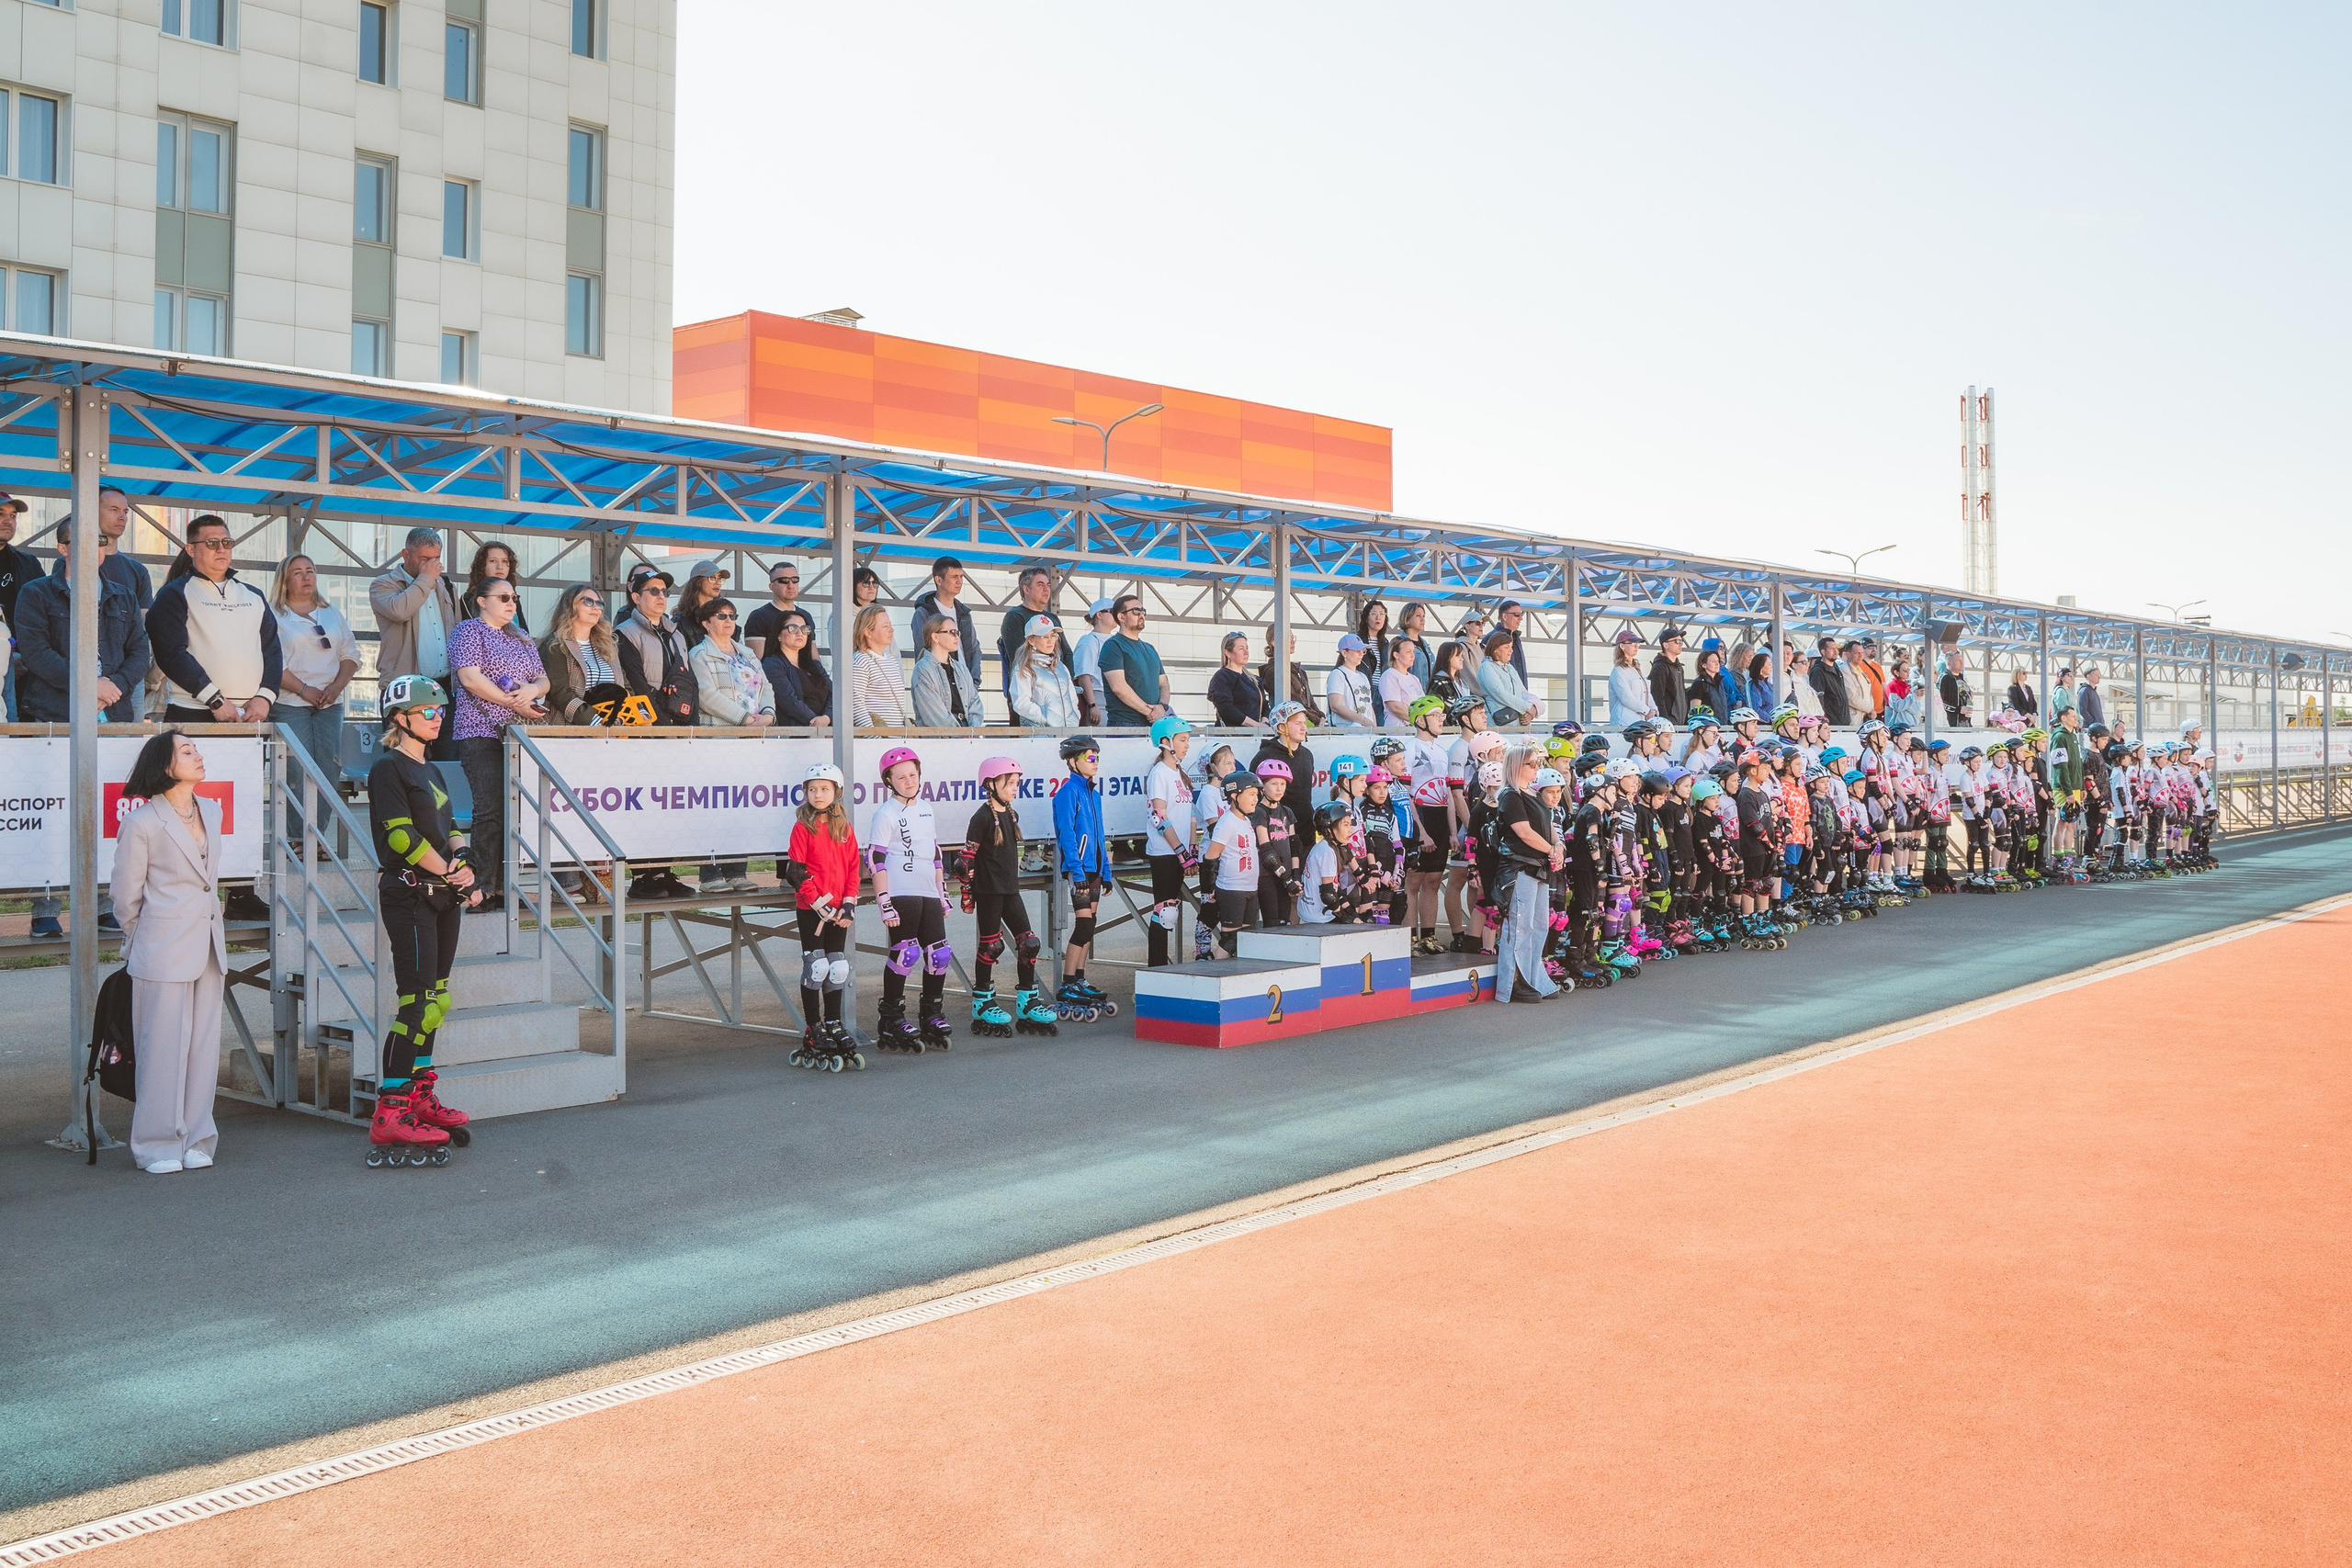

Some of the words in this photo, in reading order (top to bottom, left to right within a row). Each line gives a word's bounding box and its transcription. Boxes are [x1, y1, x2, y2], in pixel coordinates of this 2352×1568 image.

[363, 732, 371, 746] 3
[1374, 746, 1386, 754] 394
[650, 784, 806, 811] ЧЕМПИОНО
[1360, 953, 1374, 996] 1
[1467, 969, 1480, 1002] 3
[1266, 985, 1283, 1024] 2
